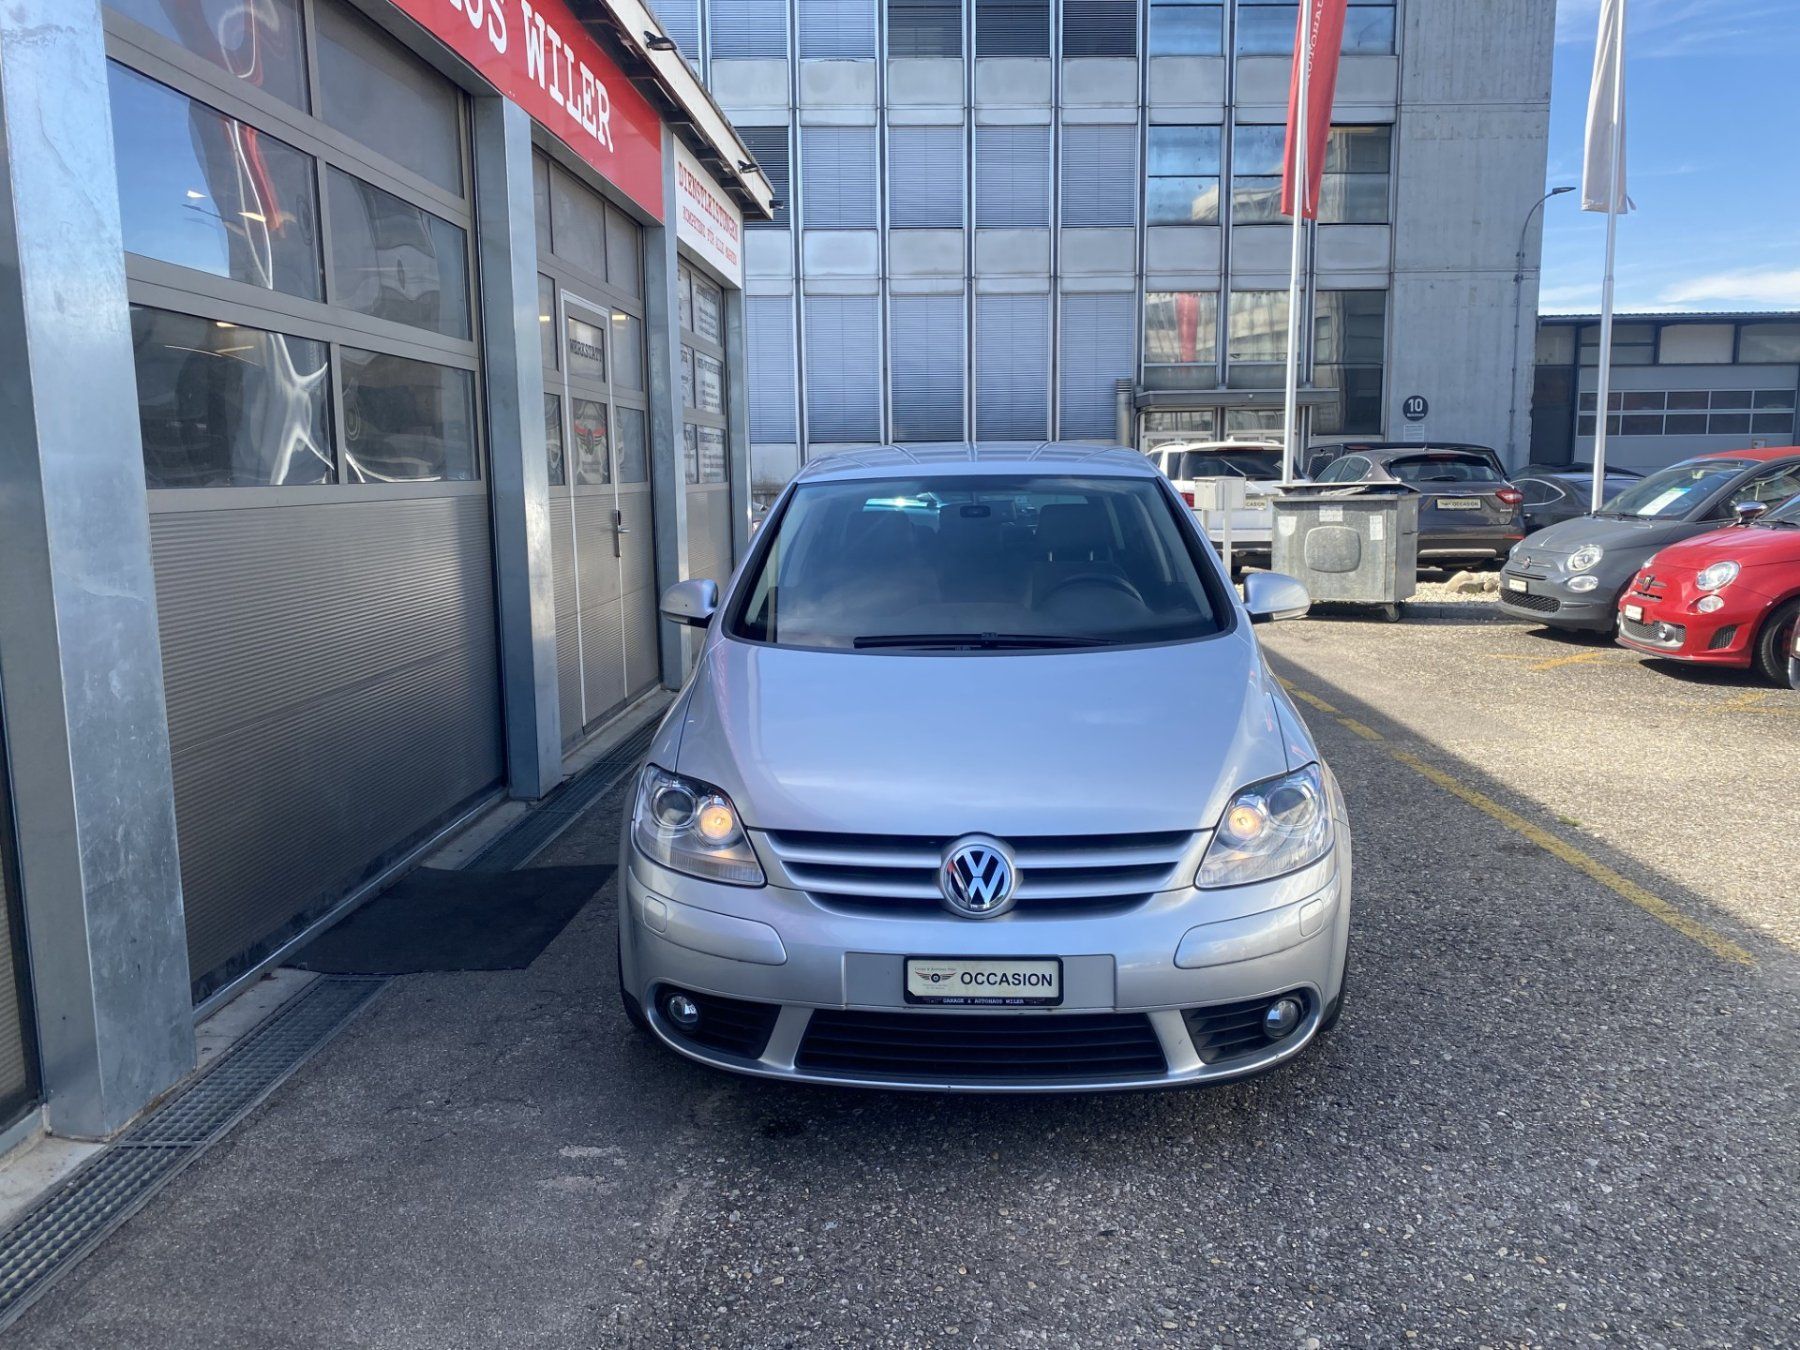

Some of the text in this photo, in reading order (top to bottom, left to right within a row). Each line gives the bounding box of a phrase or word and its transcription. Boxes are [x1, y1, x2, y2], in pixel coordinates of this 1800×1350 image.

[521, 0, 614, 153] WILER
[1408, 398, 1423, 412] 10
[947, 845, 1010, 912] VW
[960, 971, 1053, 987] OCCASION
